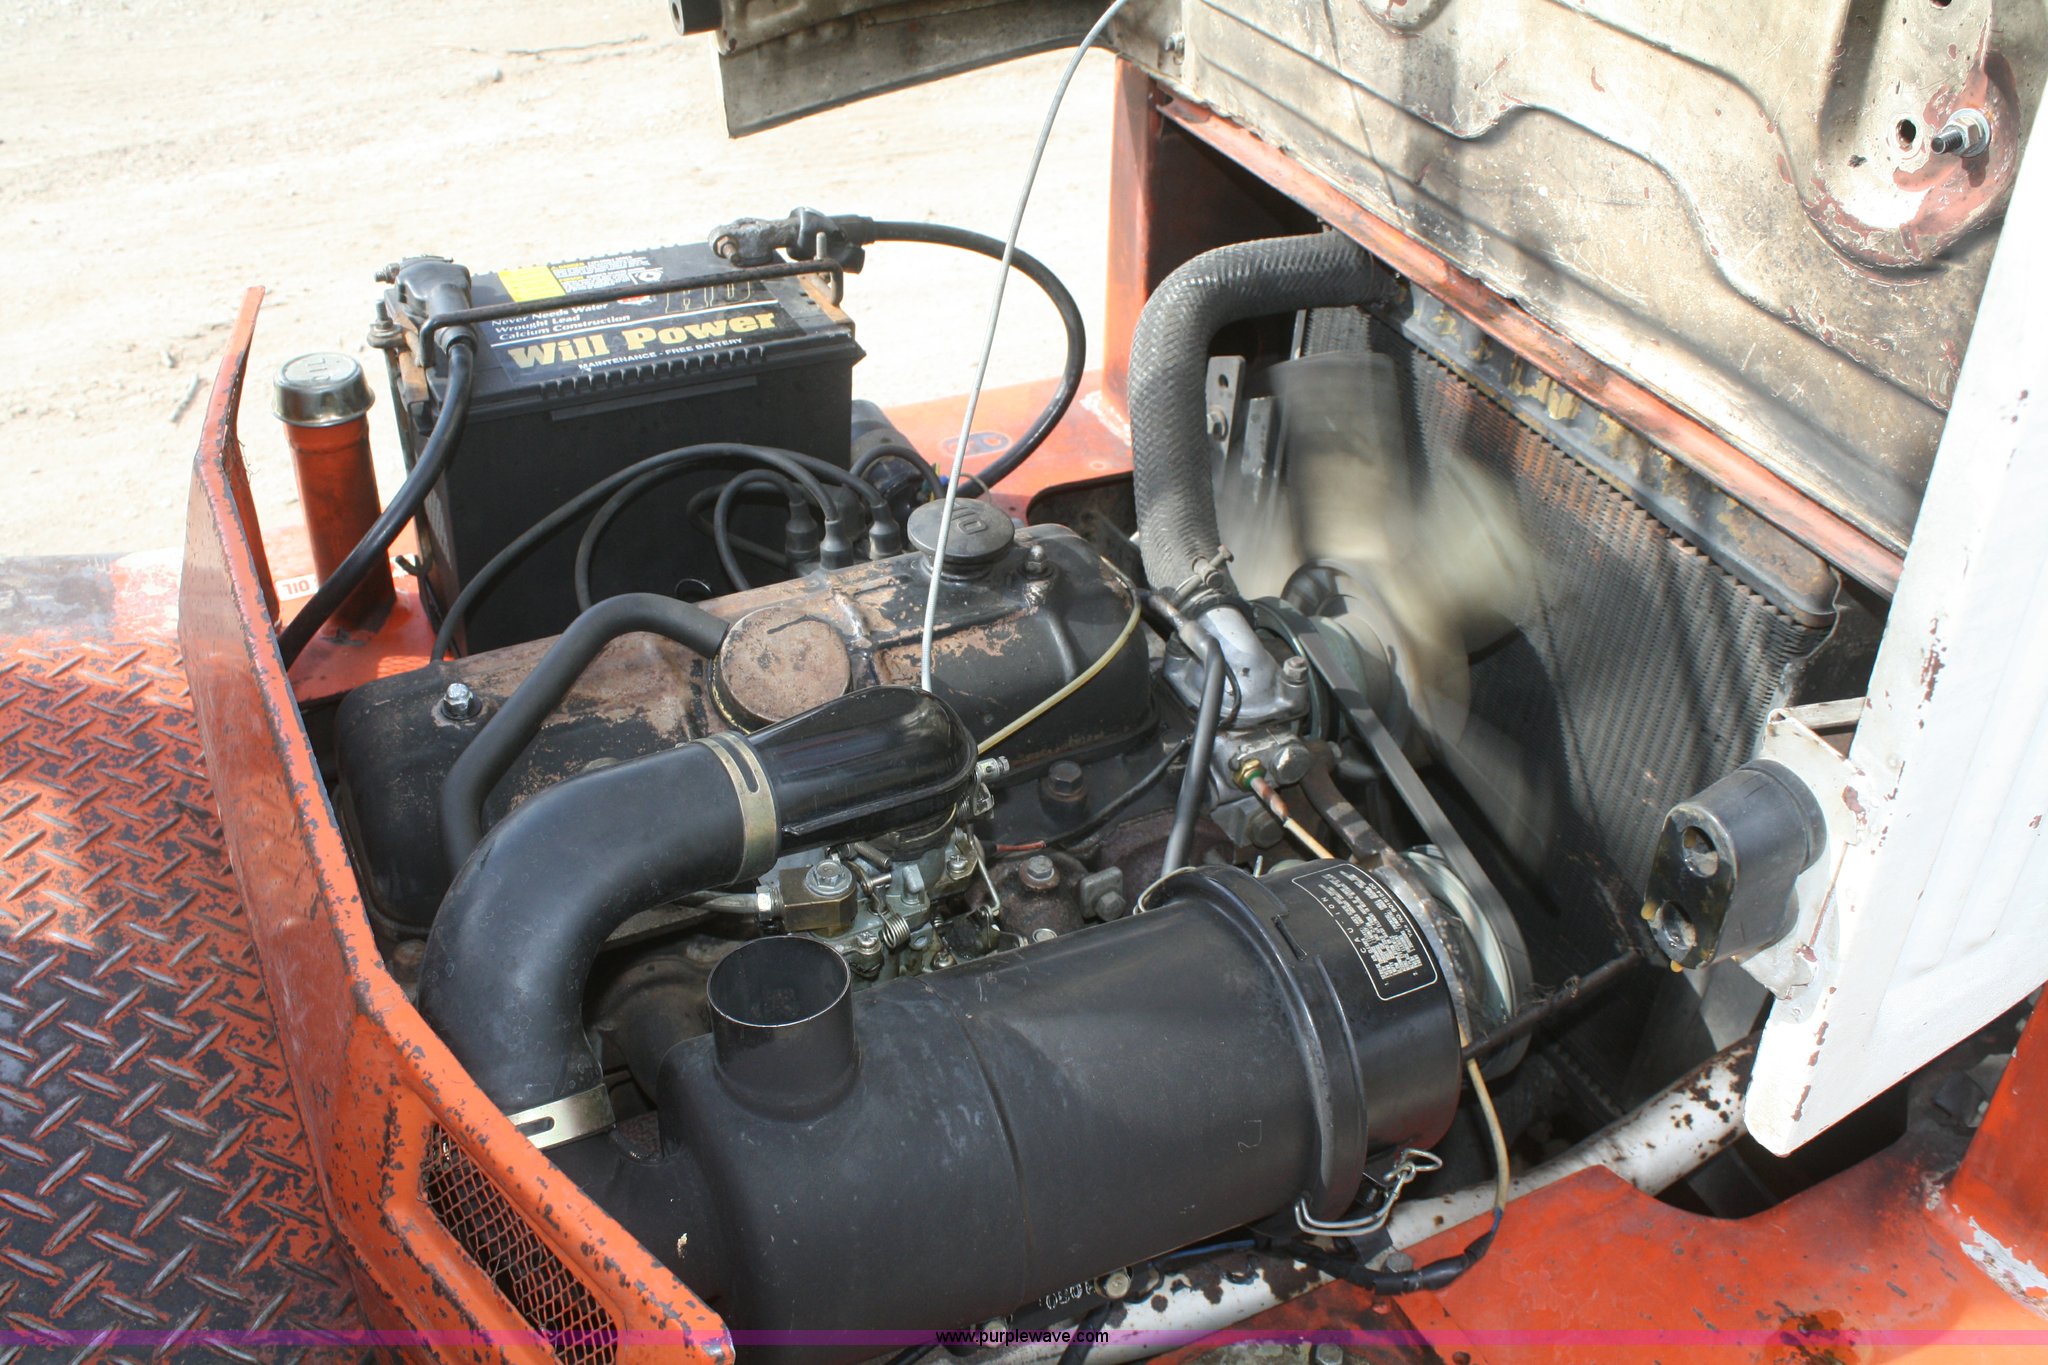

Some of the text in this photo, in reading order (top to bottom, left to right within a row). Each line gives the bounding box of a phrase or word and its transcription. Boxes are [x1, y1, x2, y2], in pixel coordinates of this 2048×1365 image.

[491, 303, 608, 327] Never Needs Water
[495, 314, 581, 333] Wrought Lead
[499, 314, 631, 341] Calcium Construction
[508, 312, 776, 368] Will Power
[577, 352, 657, 370] MAINTENANCE
[665, 346, 694, 356] FREE
[696, 338, 743, 350] BATTERY
[282, 579, 310, 596] OIL
